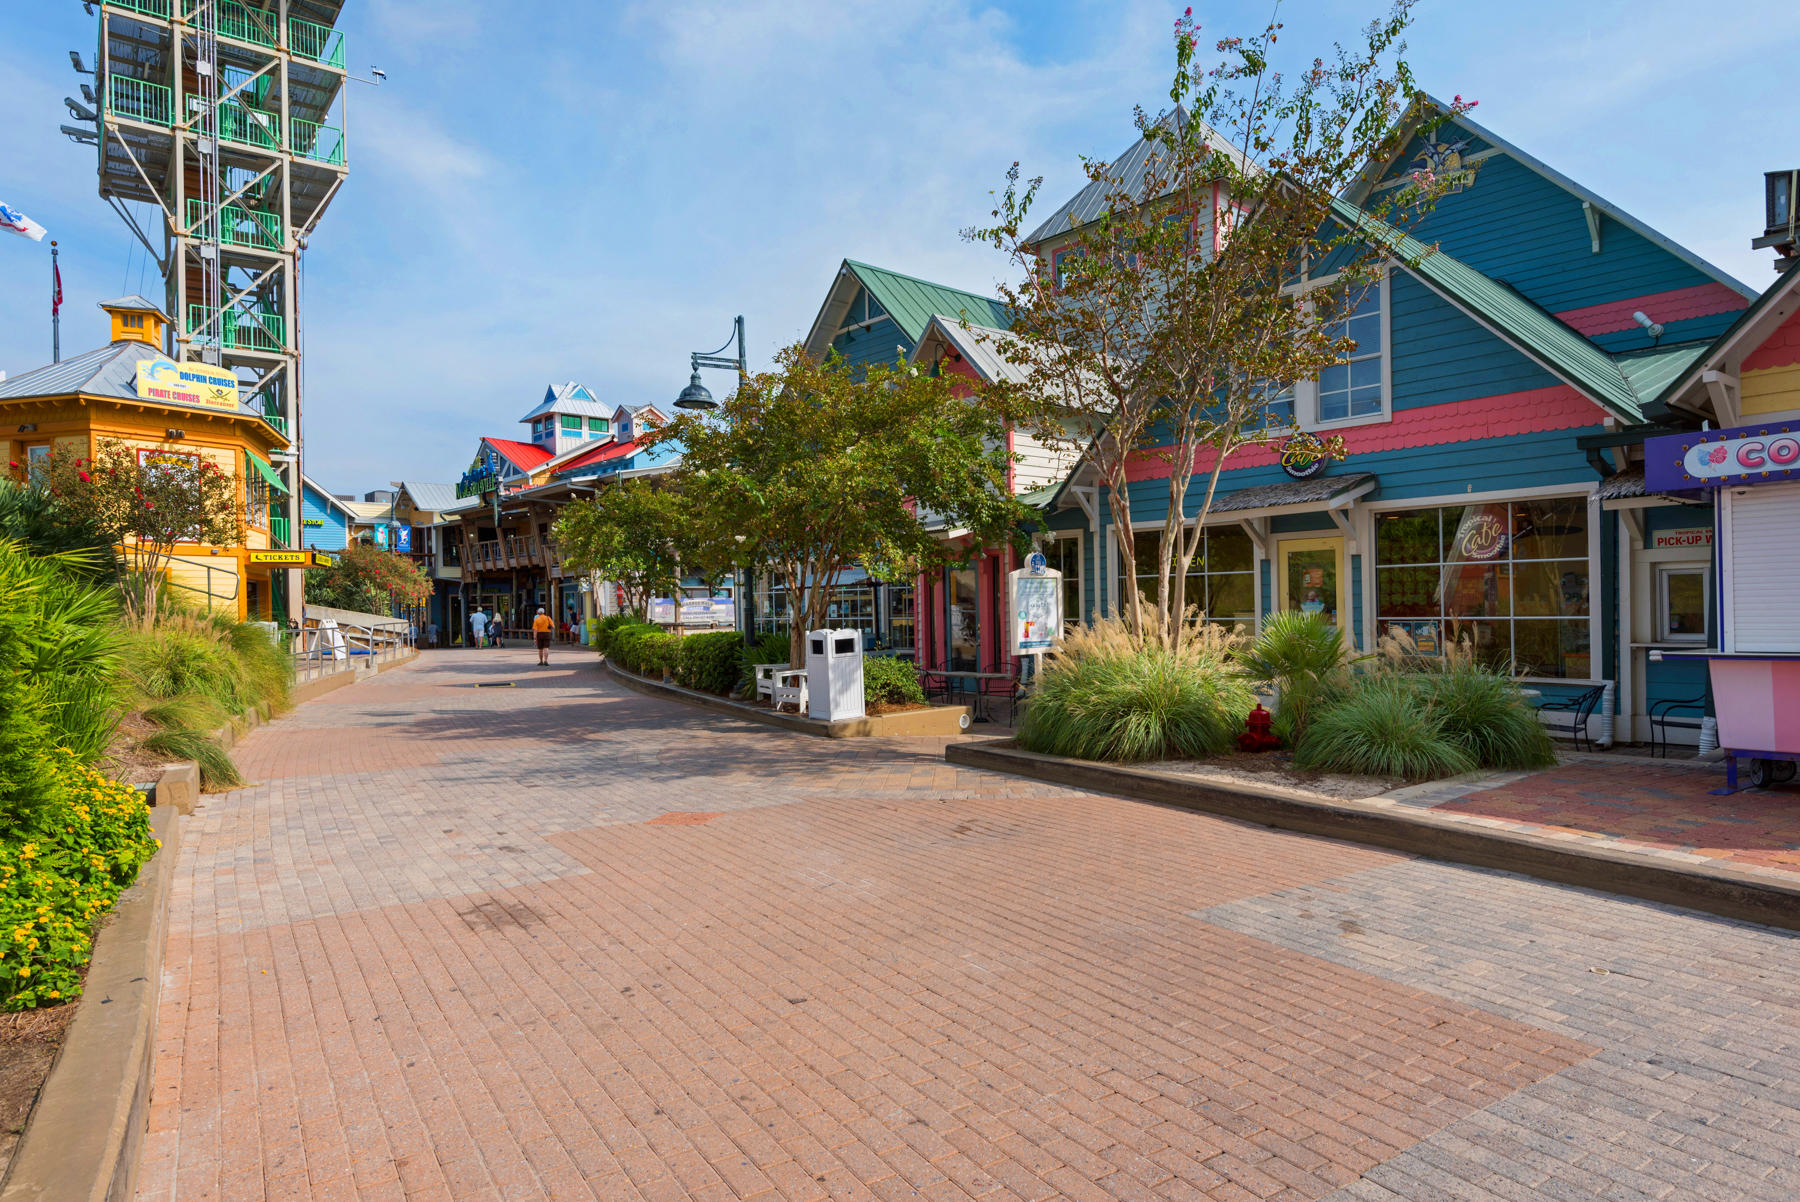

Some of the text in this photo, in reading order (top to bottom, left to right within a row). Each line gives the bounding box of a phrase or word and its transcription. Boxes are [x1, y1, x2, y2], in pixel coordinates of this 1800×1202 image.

[179, 371, 207, 384] DOLPHIN
[208, 376, 235, 388] CRUISES
[148, 387, 171, 399] PIRATE
[172, 391, 200, 404] CRUISES
[1458, 515, 1492, 539] Tropical
[1657, 535, 1702, 546] PICK-UP
